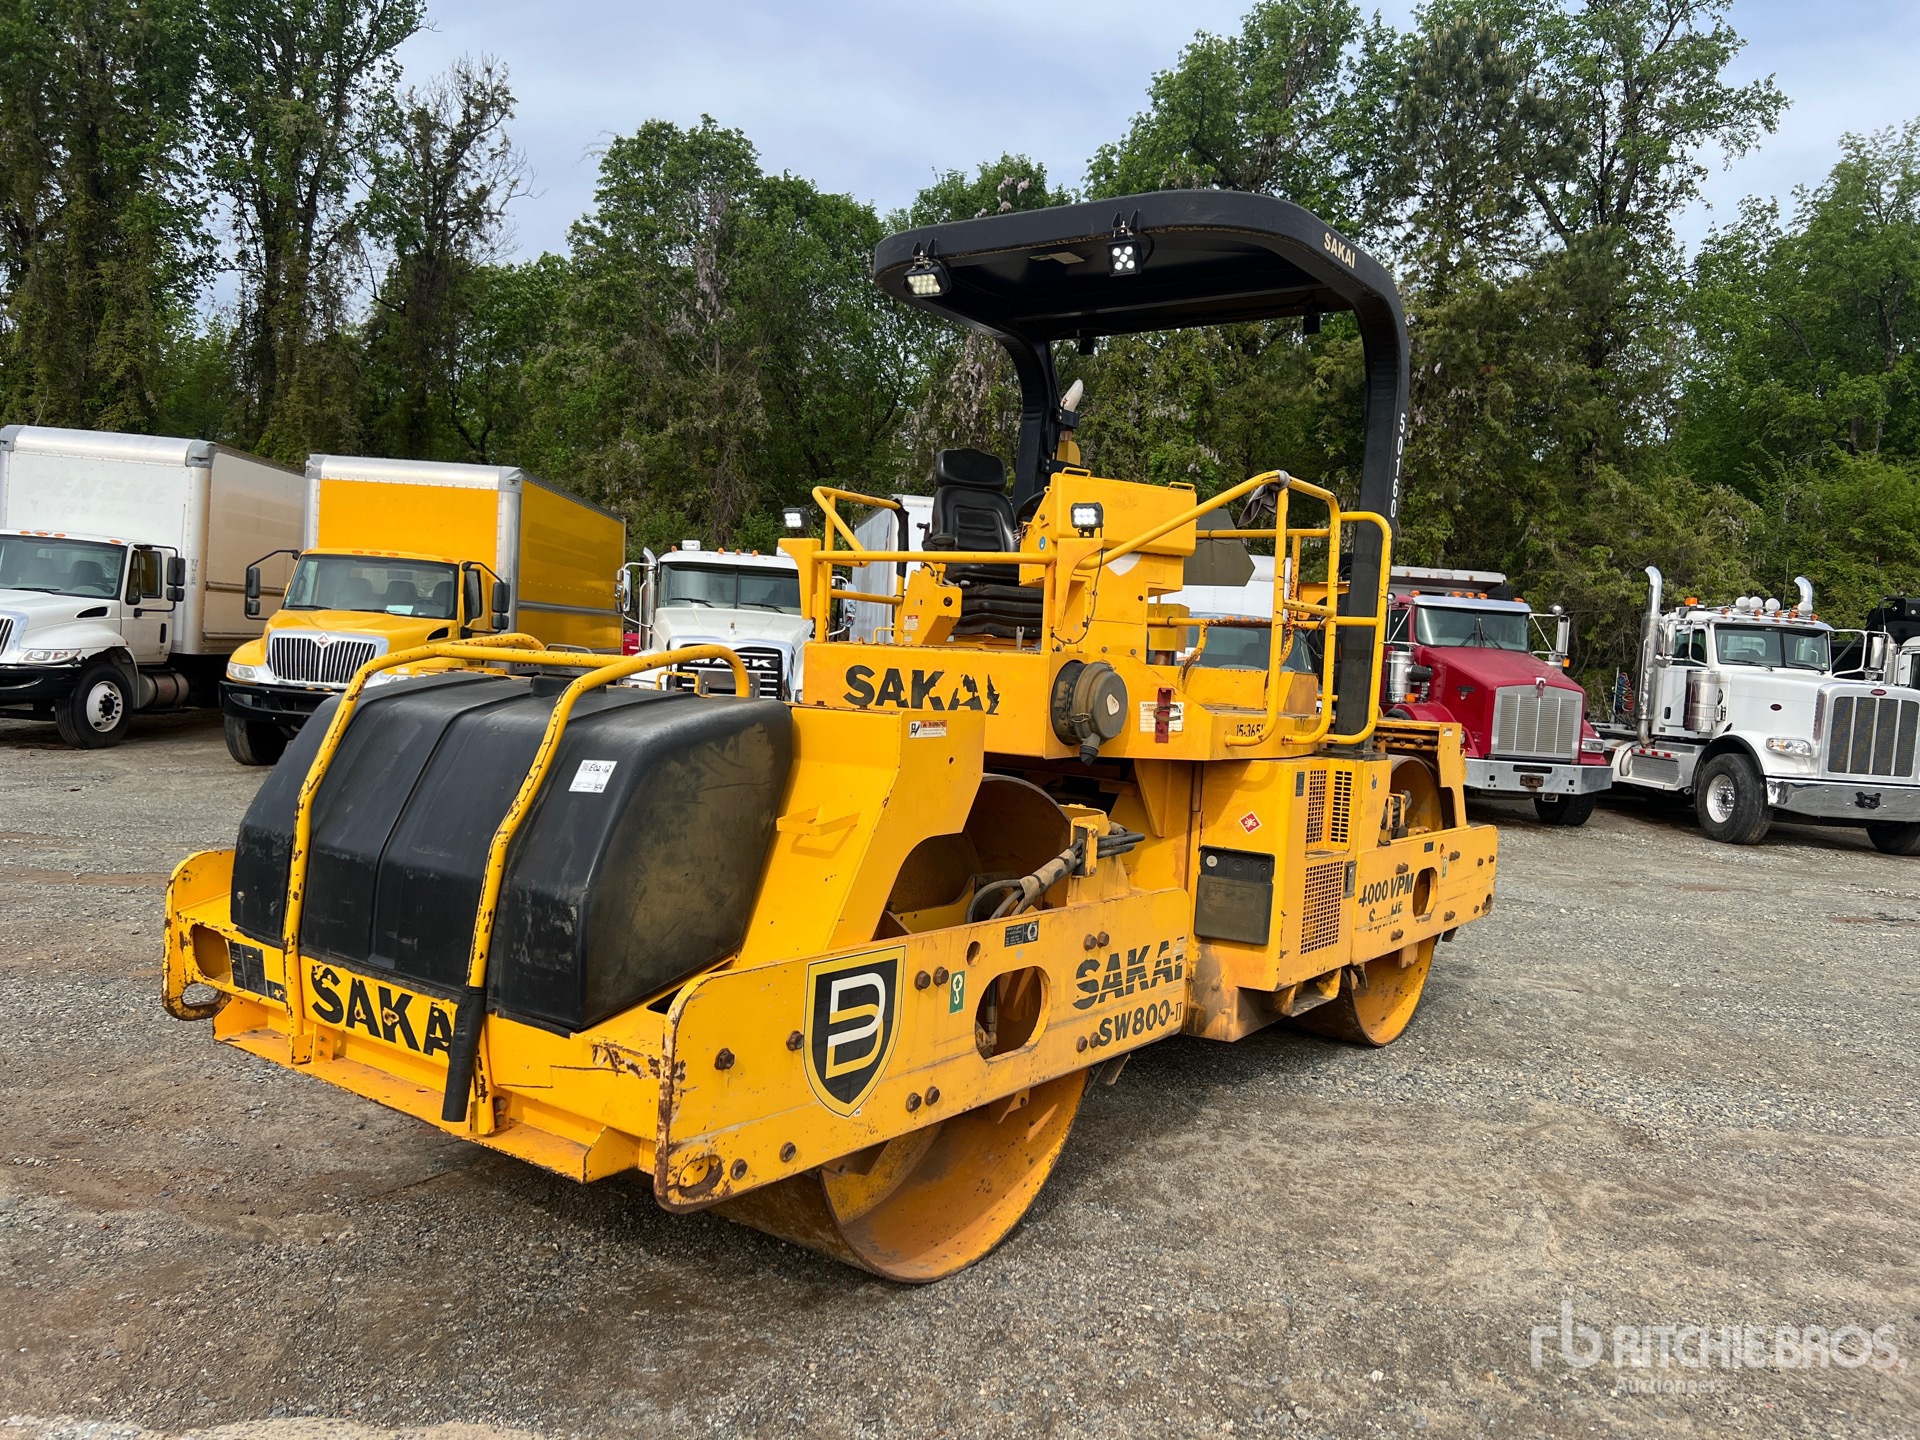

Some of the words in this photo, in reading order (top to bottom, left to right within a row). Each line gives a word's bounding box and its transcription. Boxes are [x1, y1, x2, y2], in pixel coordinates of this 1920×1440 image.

[1324, 232, 1356, 269] SAKAI
[1390, 412, 1406, 518] 50160
[843, 664, 1000, 716] SAKAI
[1358, 879, 1389, 907] 4000
[1391, 873, 1414, 899] VPM
[1072, 936, 1184, 1010] SAKAI
[311, 965, 454, 1056] SAKA
